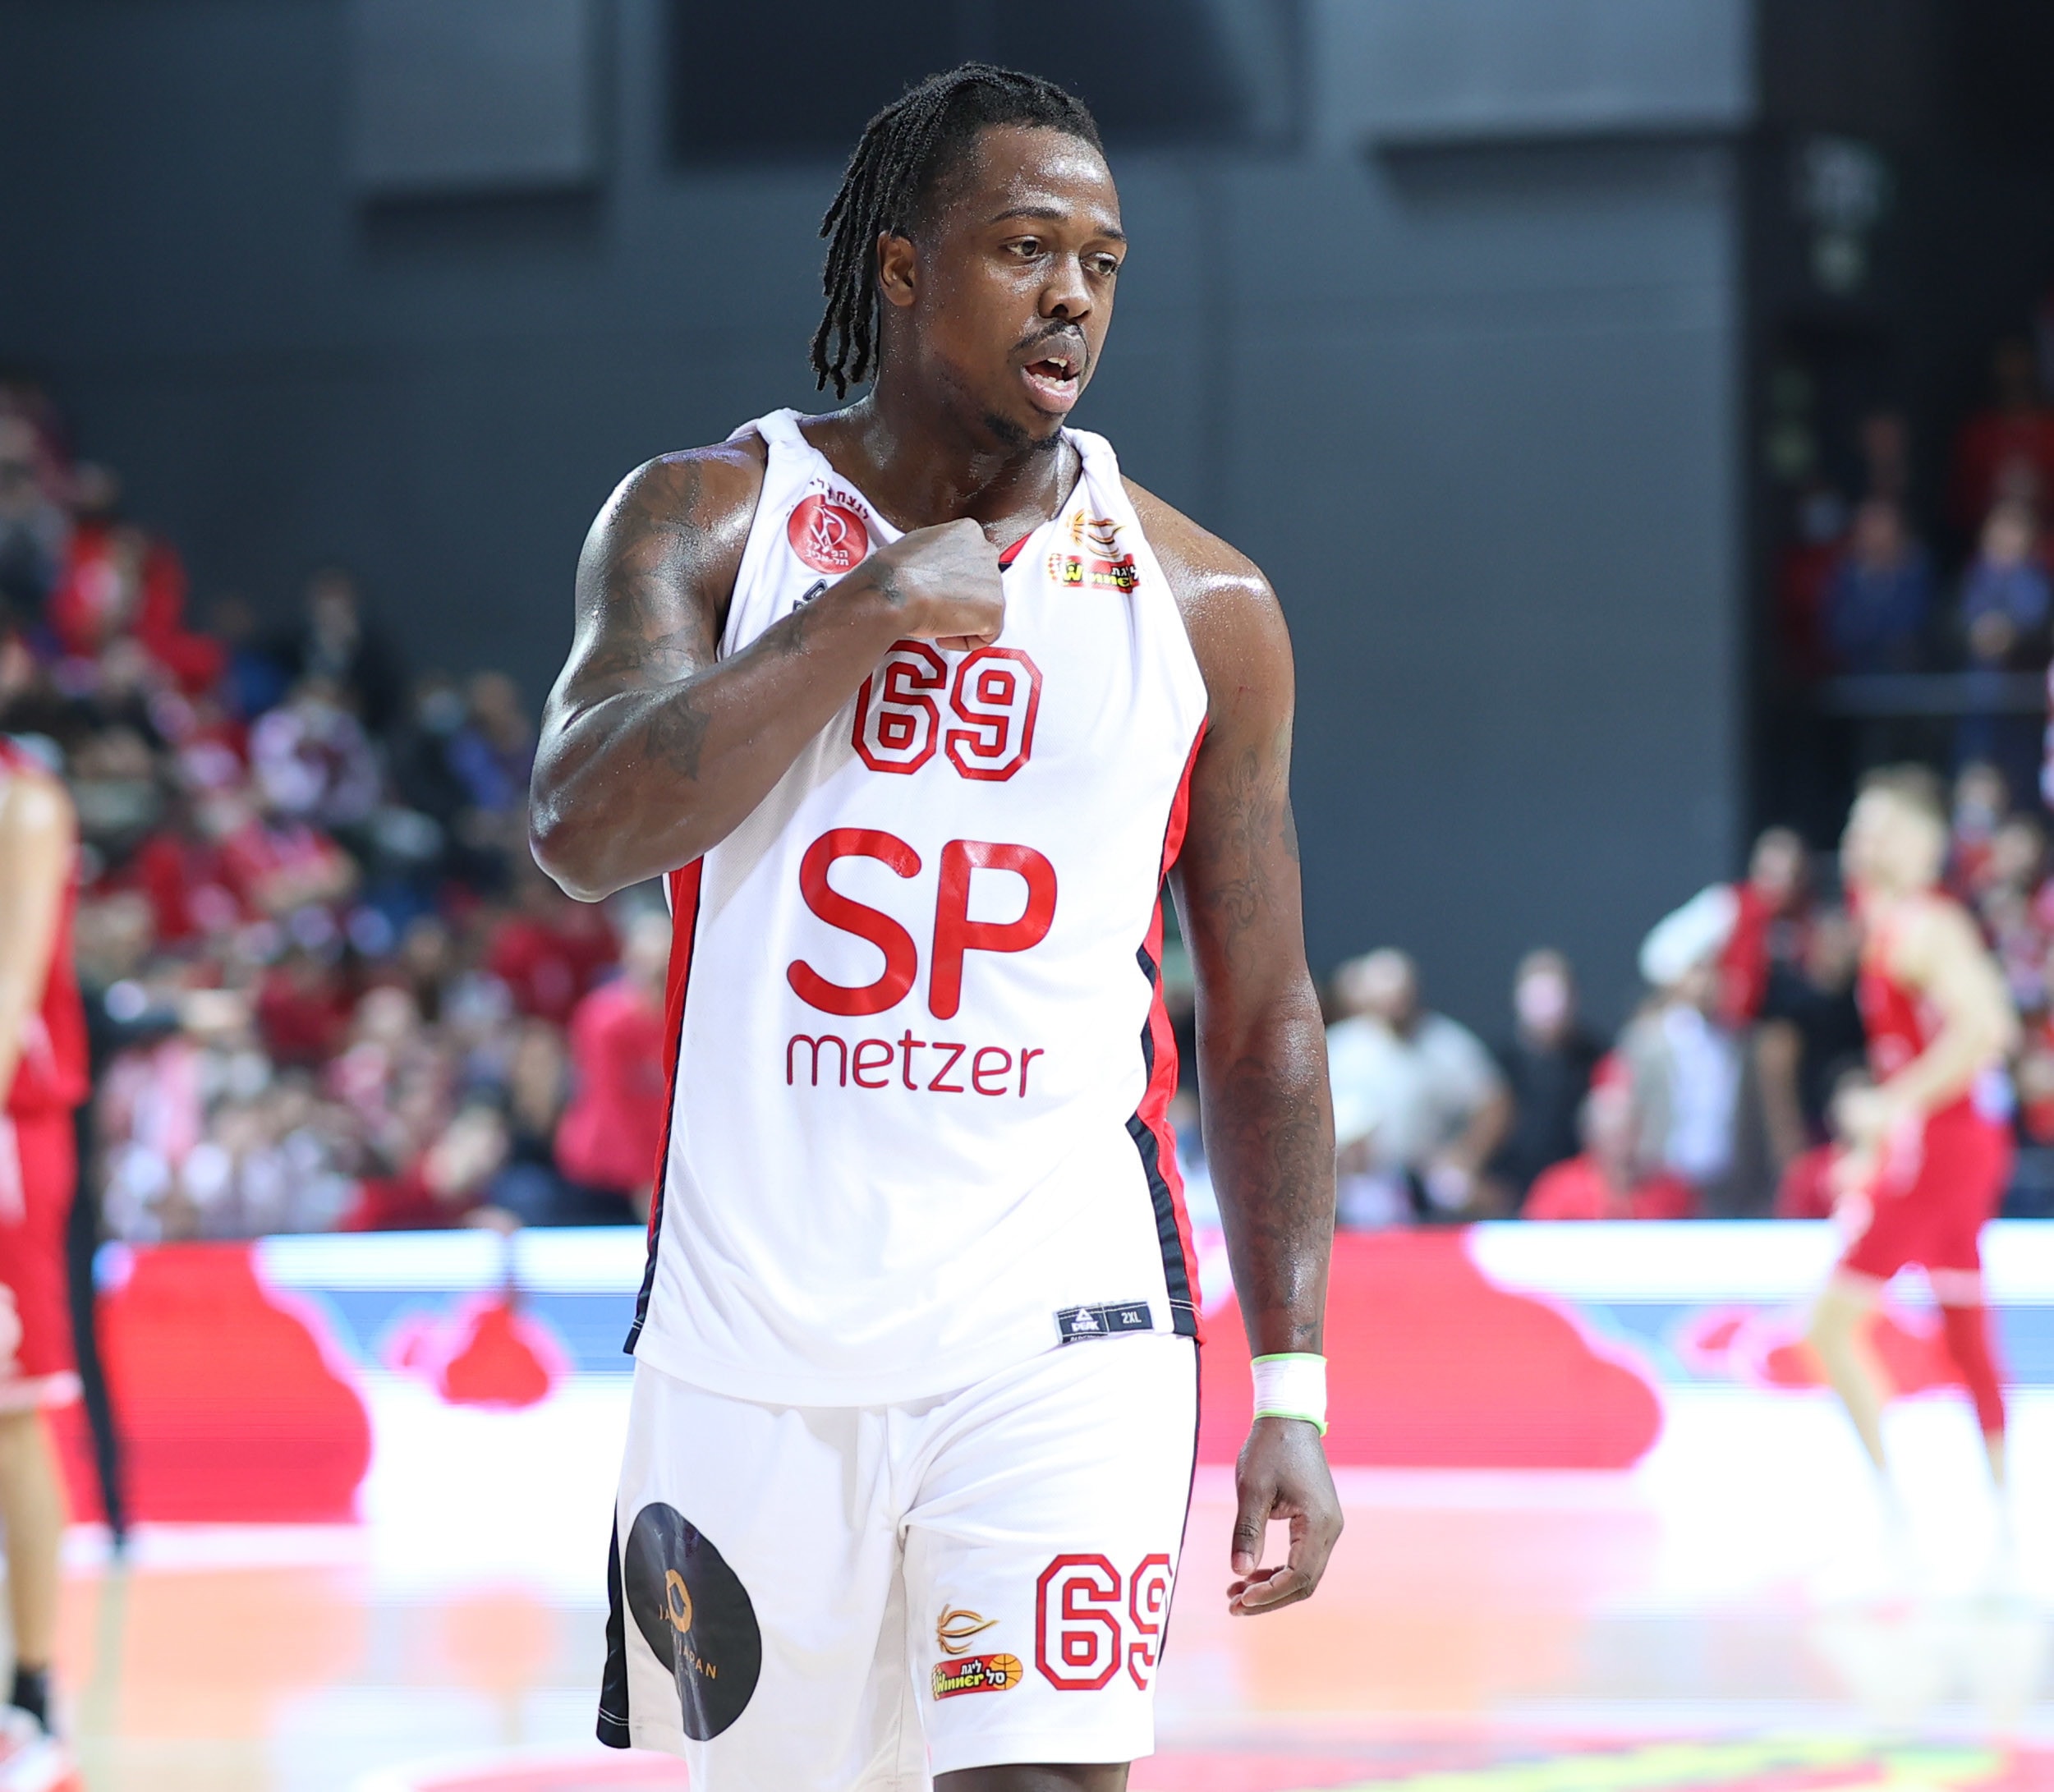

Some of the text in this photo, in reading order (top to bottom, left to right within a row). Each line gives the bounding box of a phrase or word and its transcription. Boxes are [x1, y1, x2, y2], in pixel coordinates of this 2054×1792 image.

[807, 539, 848, 558] הפעל
[852, 640, 1043, 781] 69
[787, 828, 1057, 1019] SP
[787, 1029, 1044, 1097] metzer
[1071, 1321, 1100, 1332] PEAK
[1121, 1312, 1142, 1324] 2XL
[1035, 1554, 1172, 1690] 69
[961, 1660, 982, 1675] ליגת
[986, 1669, 1005, 1684] סל
[936, 1673, 984, 1693] Winner
